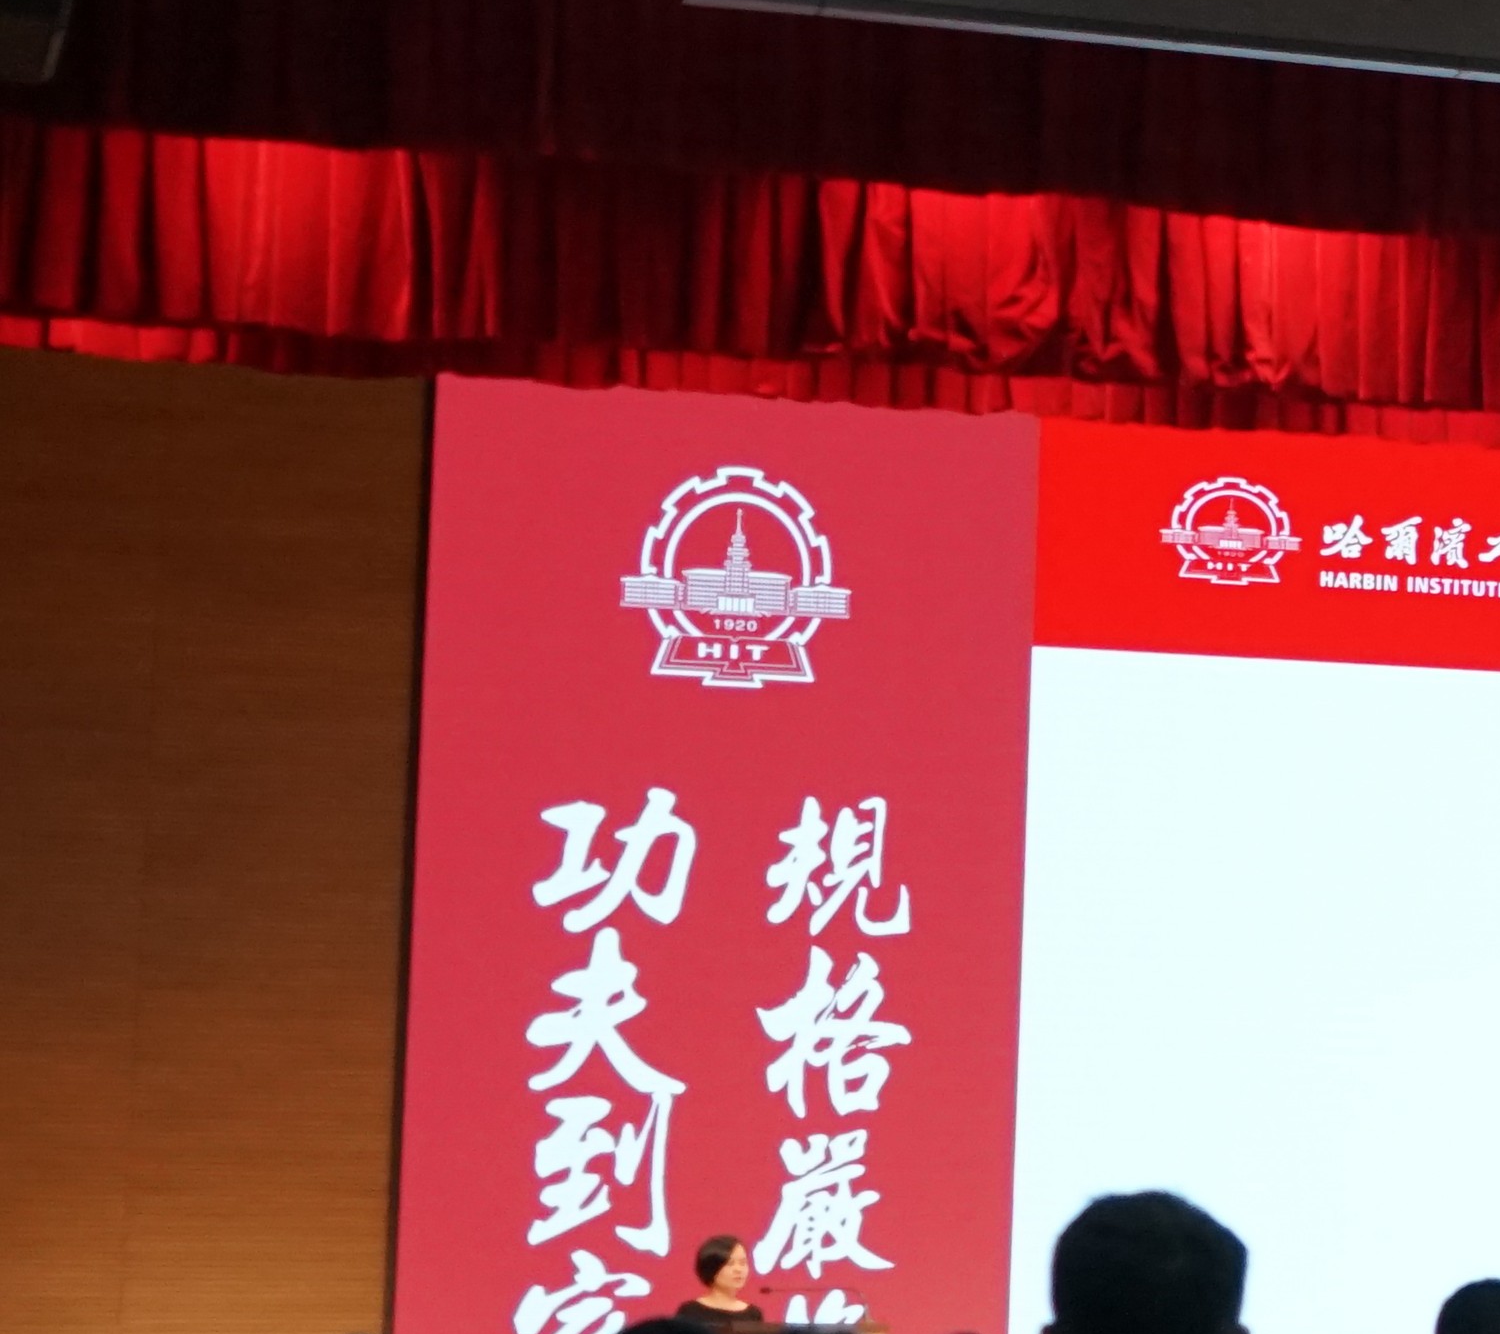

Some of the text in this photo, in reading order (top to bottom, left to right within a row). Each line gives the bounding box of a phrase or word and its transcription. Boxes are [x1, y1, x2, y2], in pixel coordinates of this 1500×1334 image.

[1319, 570, 1398, 592] HARBIN
[713, 618, 758, 632] 1920
[697, 641, 770, 661] HIT
[752, 796, 912, 1326] 規格嚴
